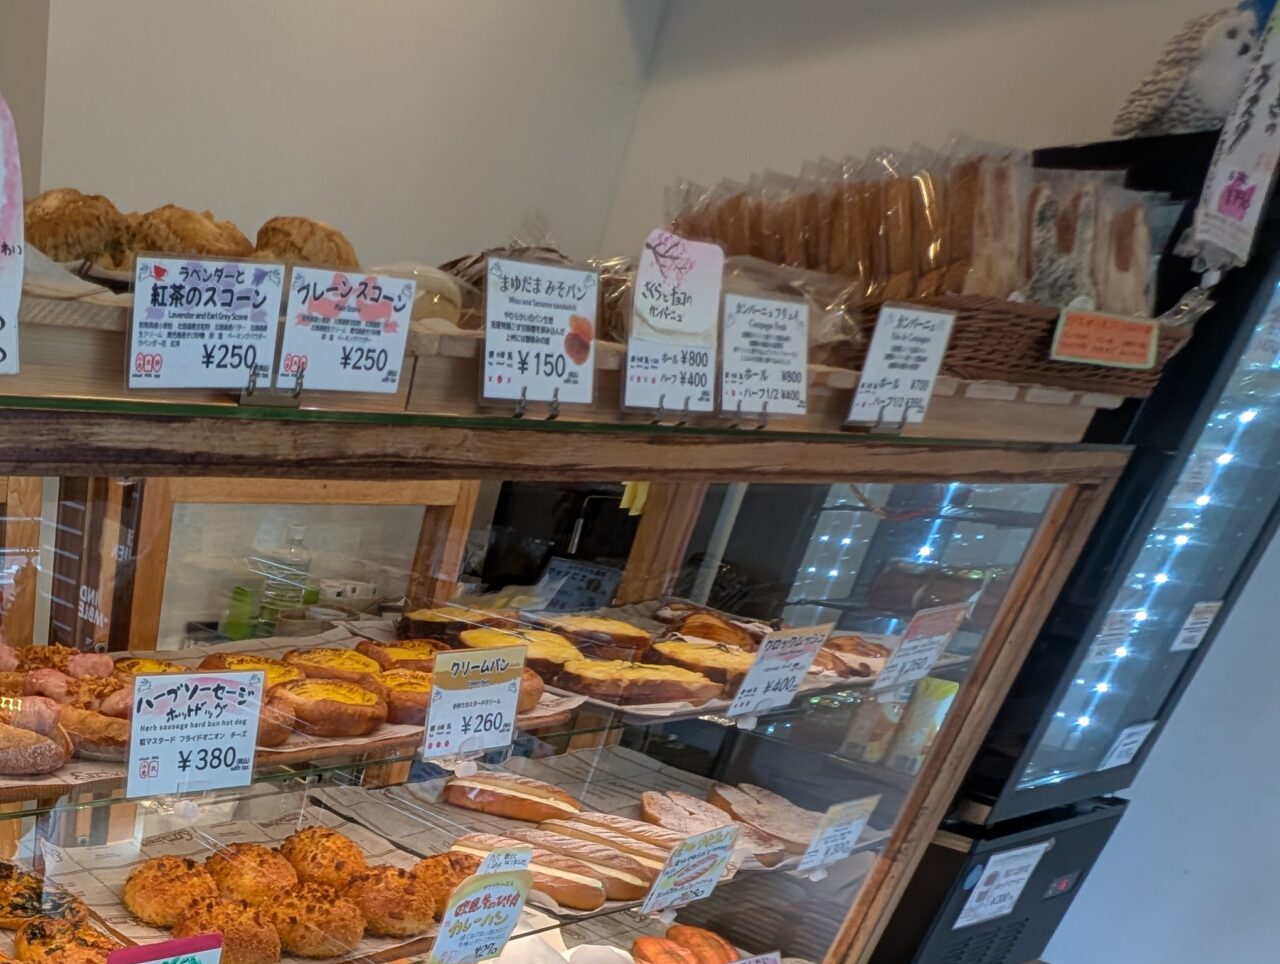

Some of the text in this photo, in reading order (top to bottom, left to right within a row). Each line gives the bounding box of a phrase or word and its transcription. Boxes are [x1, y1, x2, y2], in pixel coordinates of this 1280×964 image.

[179, 266, 246, 285] ラベンダーと
[150, 282, 267, 309] 紅茶のスコーン
[500, 275, 587, 301] まゆだま みそパン
[168, 311, 195, 319] Lavender
[201, 344, 257, 369] ¥250
[340, 346, 388, 371] ¥250
[517, 350, 566, 378] ¥150
[681, 350, 709, 368] ¥800
[679, 371, 708, 388] ¥400
[451, 657, 510, 678] クリームパン
[136, 683, 255, 713] ハーブソーセージ
[166, 701, 228, 723] ホットドッグ
[461, 712, 503, 734] ¥260
[140, 718, 248, 732] Herb sausage hard bun hot dog
[180, 733, 226, 743] フライドオニオン
[230, 730, 248, 738] チーズ
[177, 746, 237, 772] ¥380
